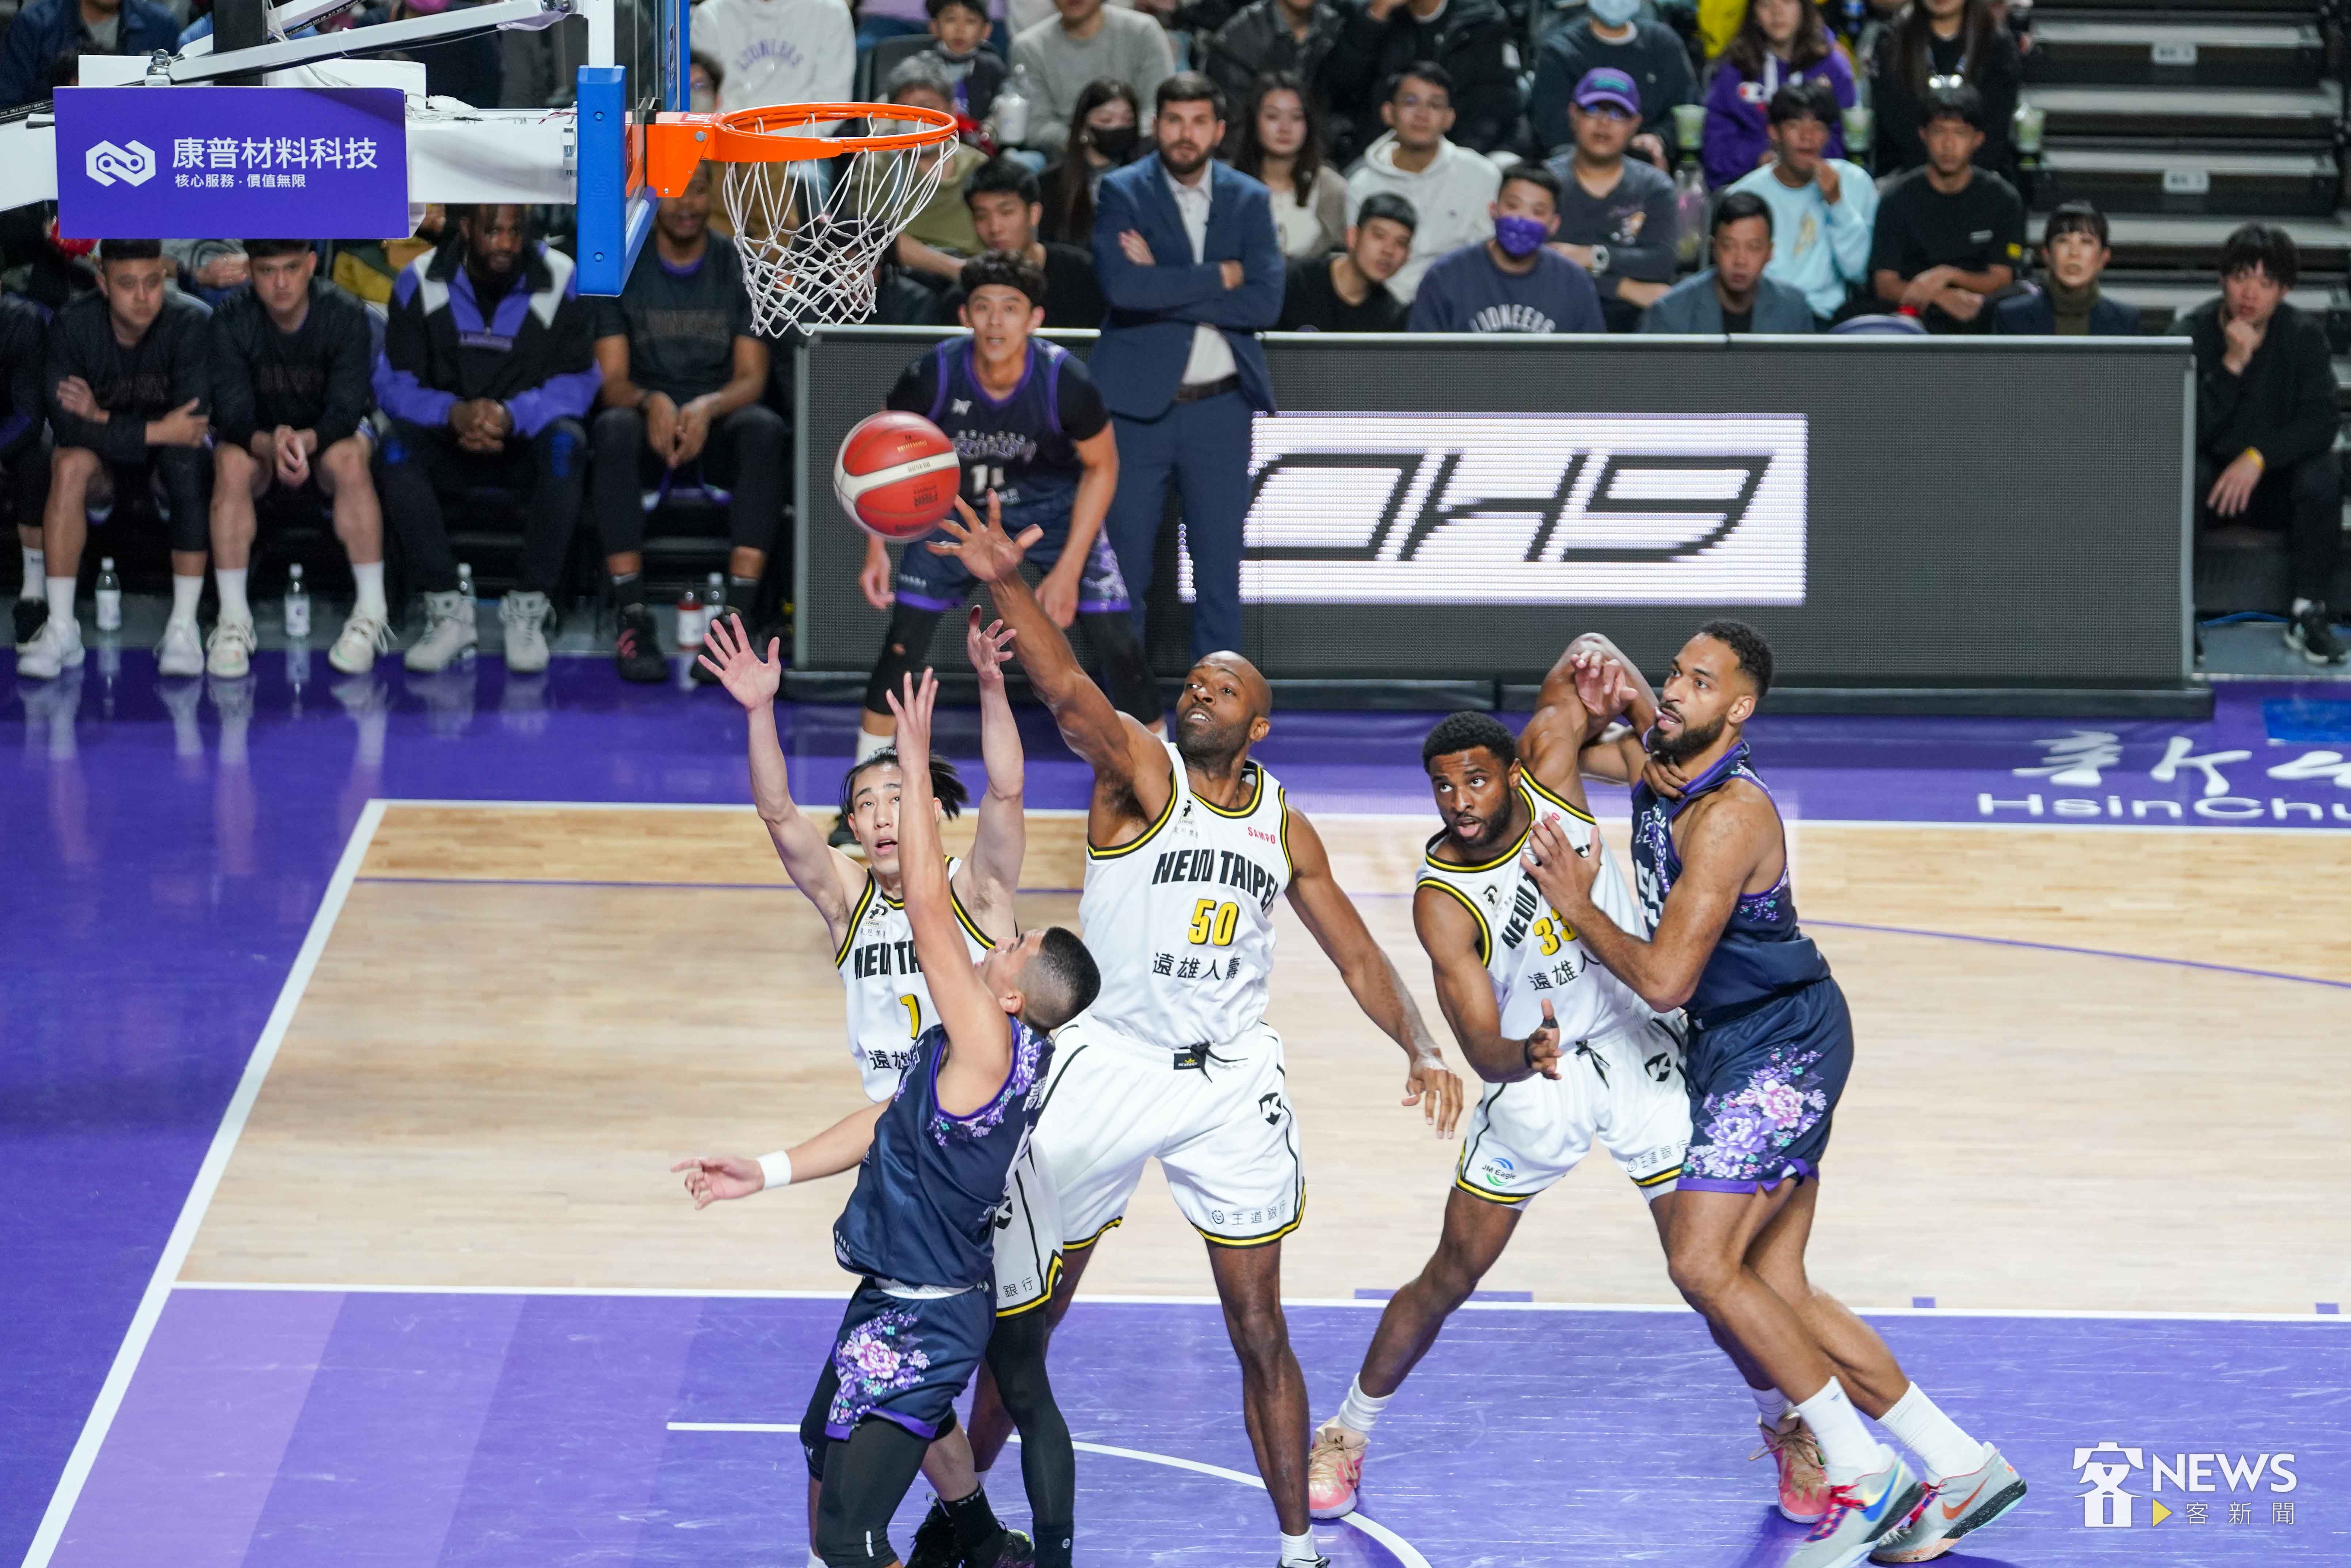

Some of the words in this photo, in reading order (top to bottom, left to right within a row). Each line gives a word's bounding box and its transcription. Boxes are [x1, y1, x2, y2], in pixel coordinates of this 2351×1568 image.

[172, 137, 378, 169] 康普材料科技
[1248, 827, 1276, 844] SAMPO
[1151, 849, 1215, 885] NEW
[1188, 898, 1240, 947] 50
[1152, 952, 1241, 981] 遠雄人壽
[1528, 950, 1600, 991] 遠雄人
[899, 993, 922, 1040] 1
[1482, 1164, 1494, 1173] JM
[1495, 1169, 1516, 1179] Eagle
[1231, 1200, 1286, 1225] 王道銀行
[1003, 1277, 1033, 1298] 銀行
